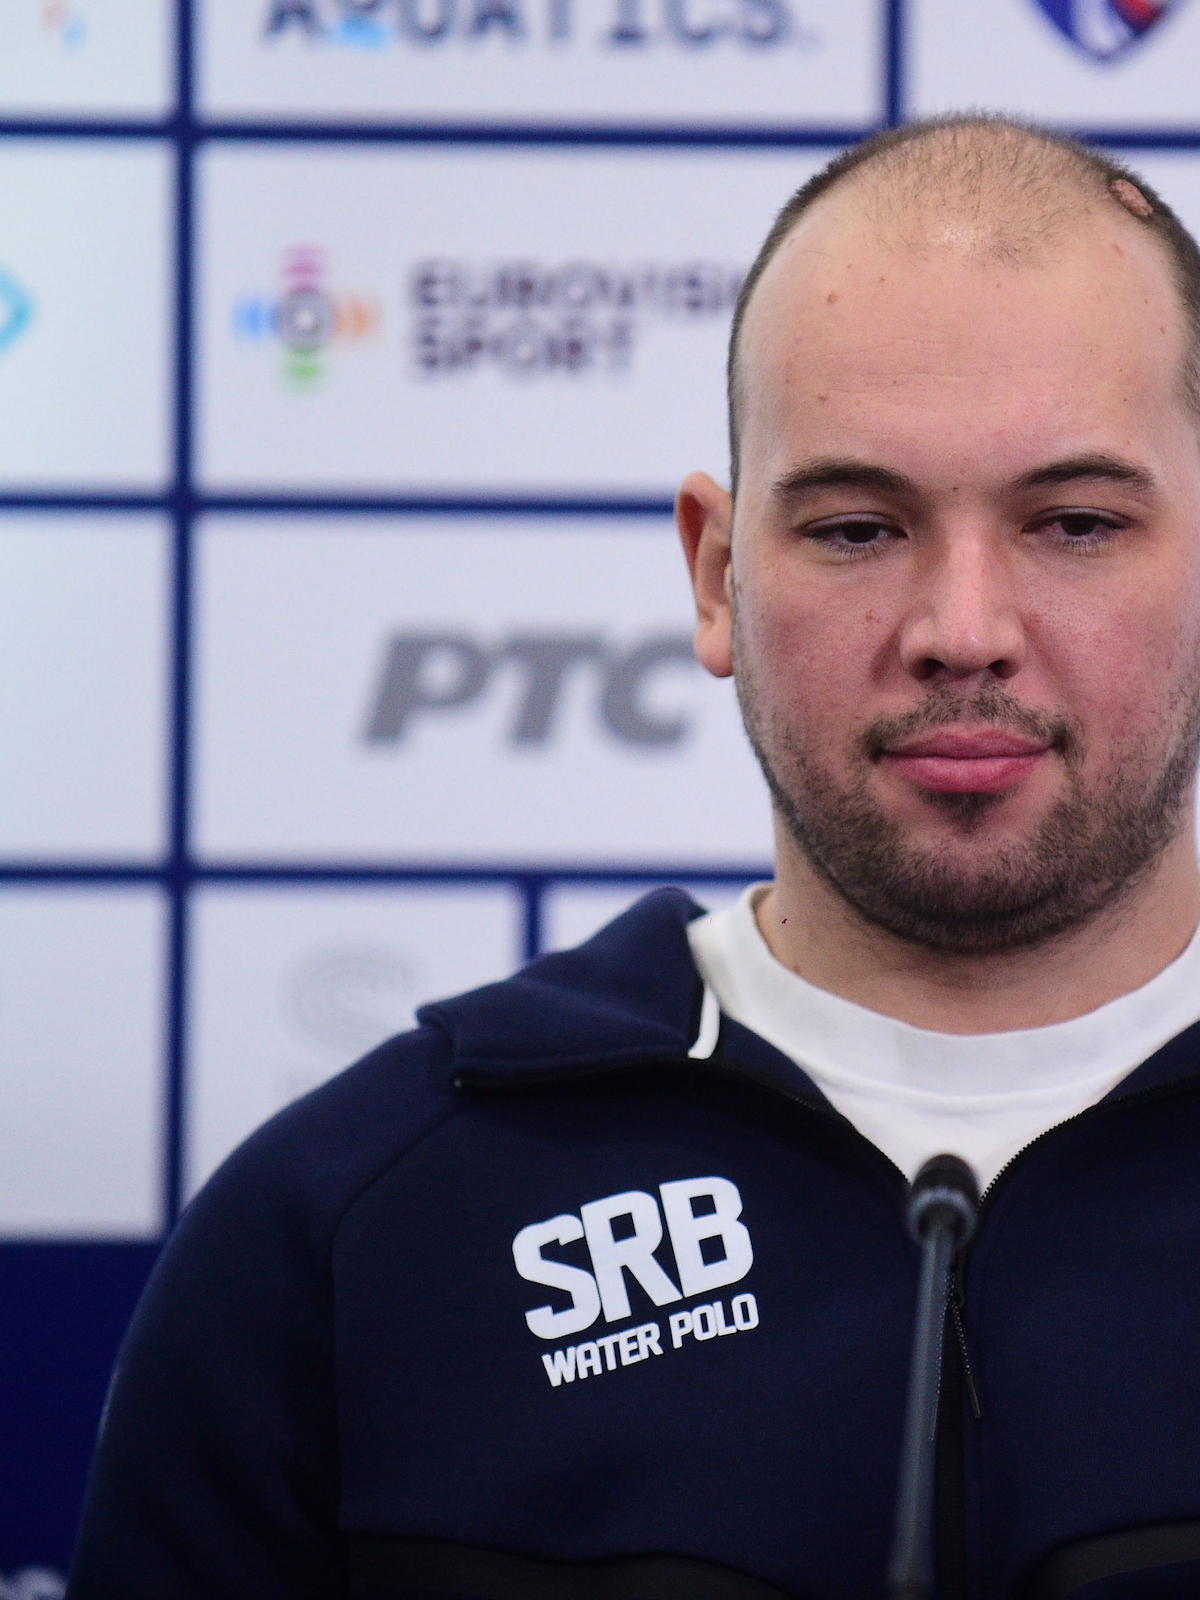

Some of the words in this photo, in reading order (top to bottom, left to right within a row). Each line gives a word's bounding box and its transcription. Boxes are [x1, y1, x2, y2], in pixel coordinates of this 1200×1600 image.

[412, 312, 634, 376] SPORT
[512, 1176, 754, 1340] SRB
[541, 1322, 664, 1387] WATER
[669, 1293, 760, 1349] POLO
